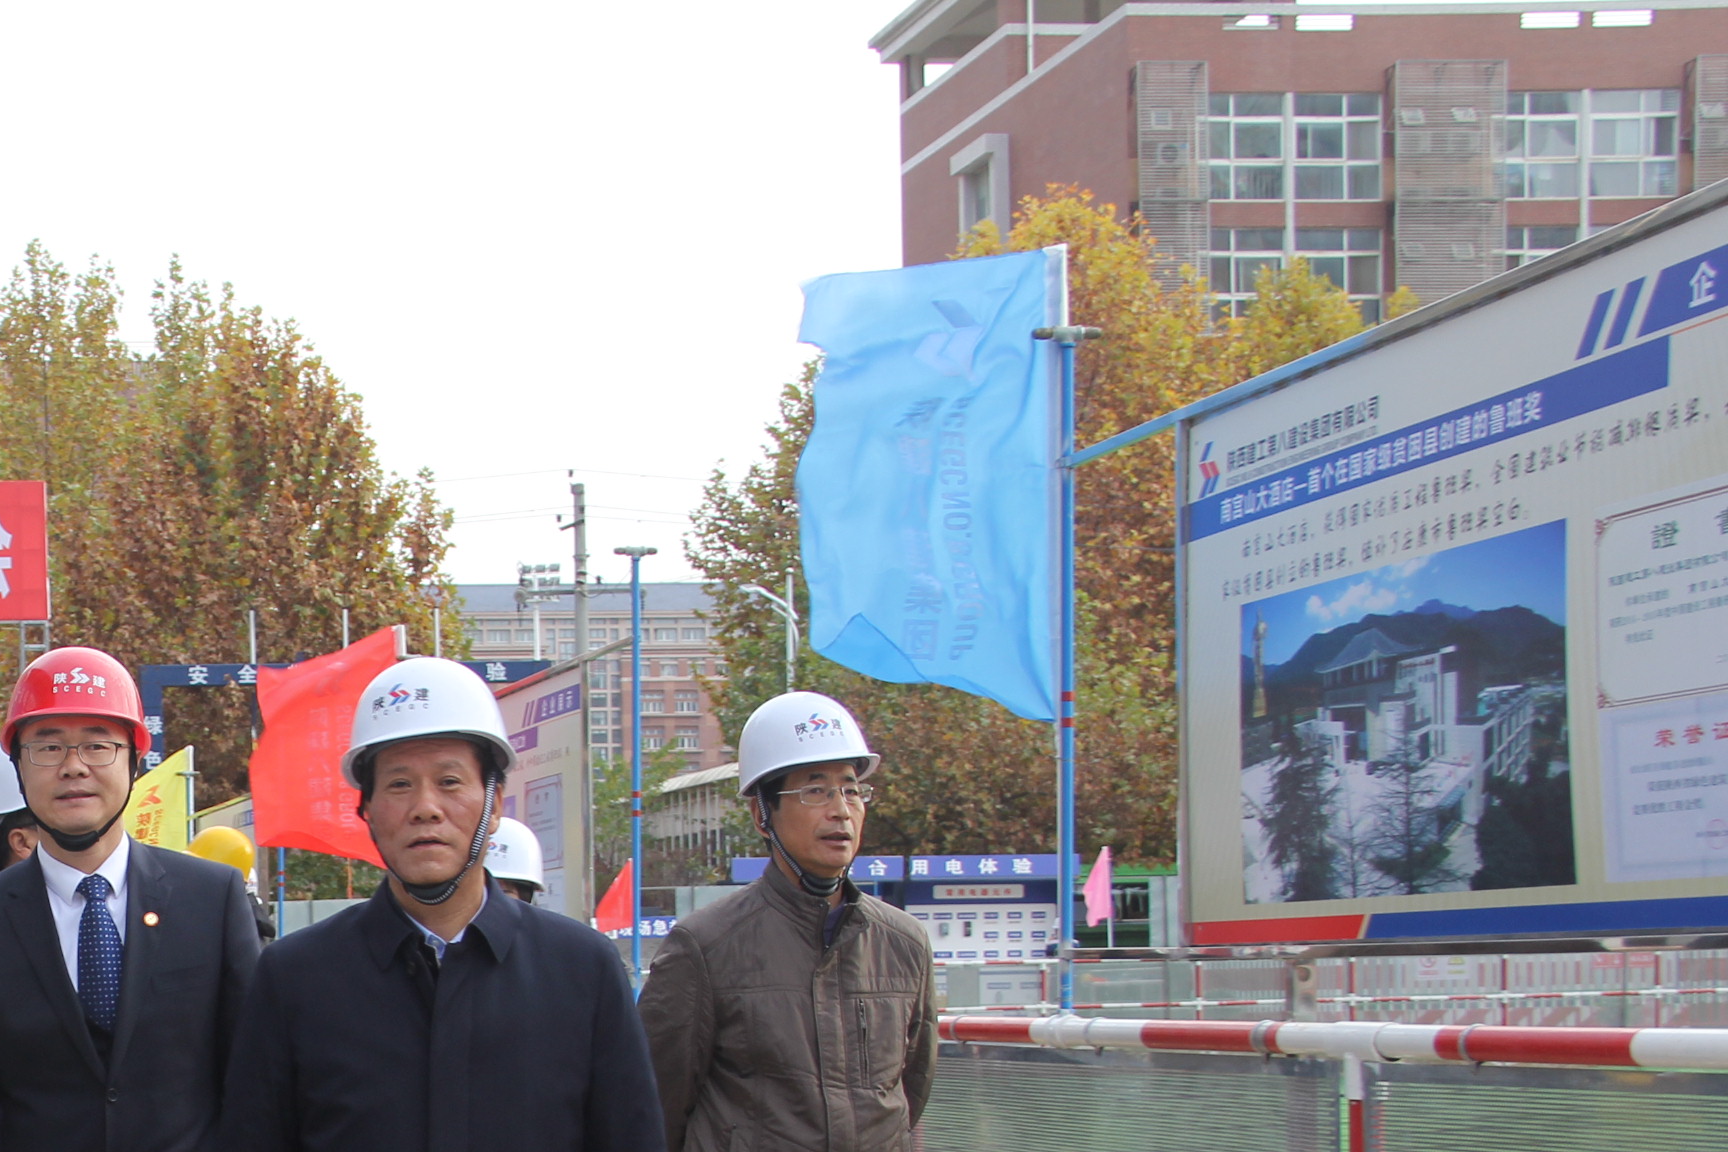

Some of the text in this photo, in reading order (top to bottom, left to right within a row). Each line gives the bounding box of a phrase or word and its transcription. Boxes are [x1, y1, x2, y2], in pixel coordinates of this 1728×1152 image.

[52, 685, 106, 697] SCEGC
[910, 857, 1033, 875] 用电体验
